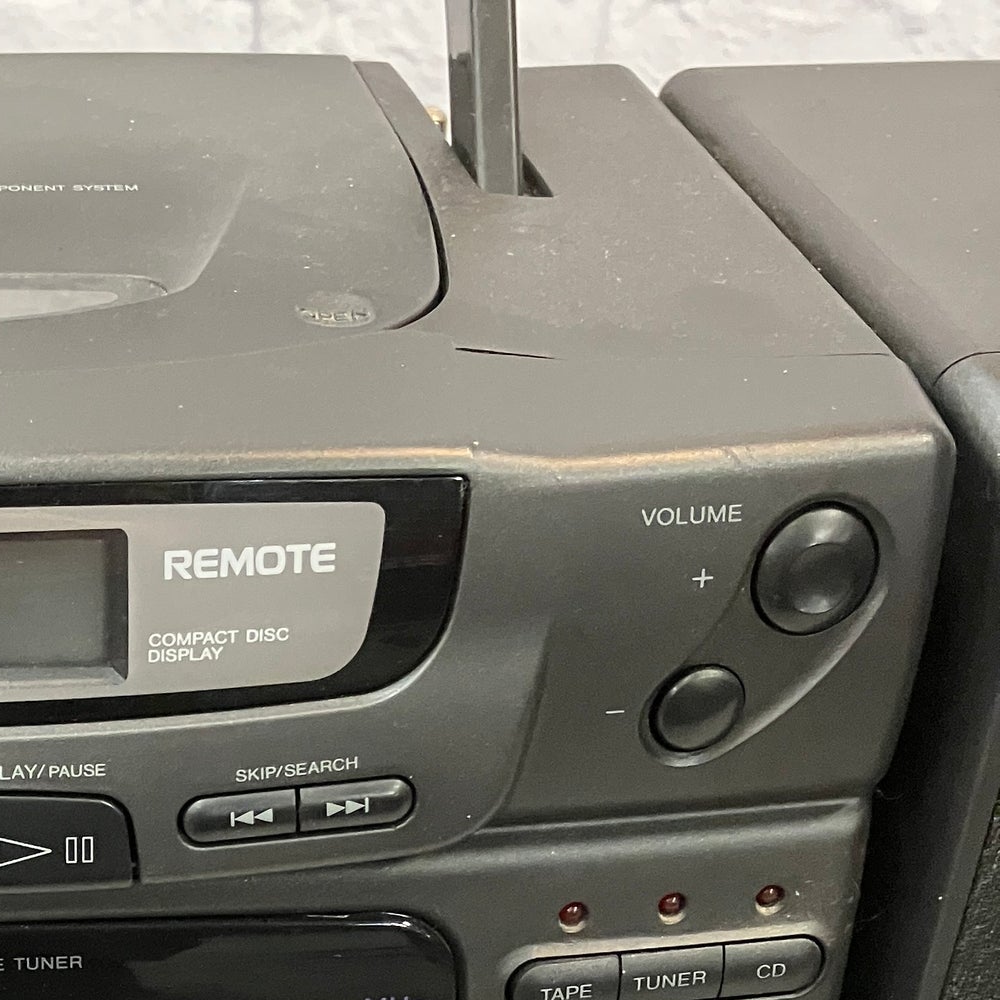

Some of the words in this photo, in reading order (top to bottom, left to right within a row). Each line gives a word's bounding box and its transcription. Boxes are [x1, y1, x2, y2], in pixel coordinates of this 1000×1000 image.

[72, 183, 139, 192] SYSTEM
[641, 503, 743, 526] VOLUME
[163, 542, 337, 581] REMOTE
[148, 629, 239, 647] COMPACT
[246, 627, 289, 643] DISC
[148, 647, 224, 663] DISPLAY
[234, 756, 359, 784] SKIP/SEARCH
[14, 955, 83, 971] TUNER
[756, 963, 786, 979] CD
[633, 970, 707, 991] TUNER
